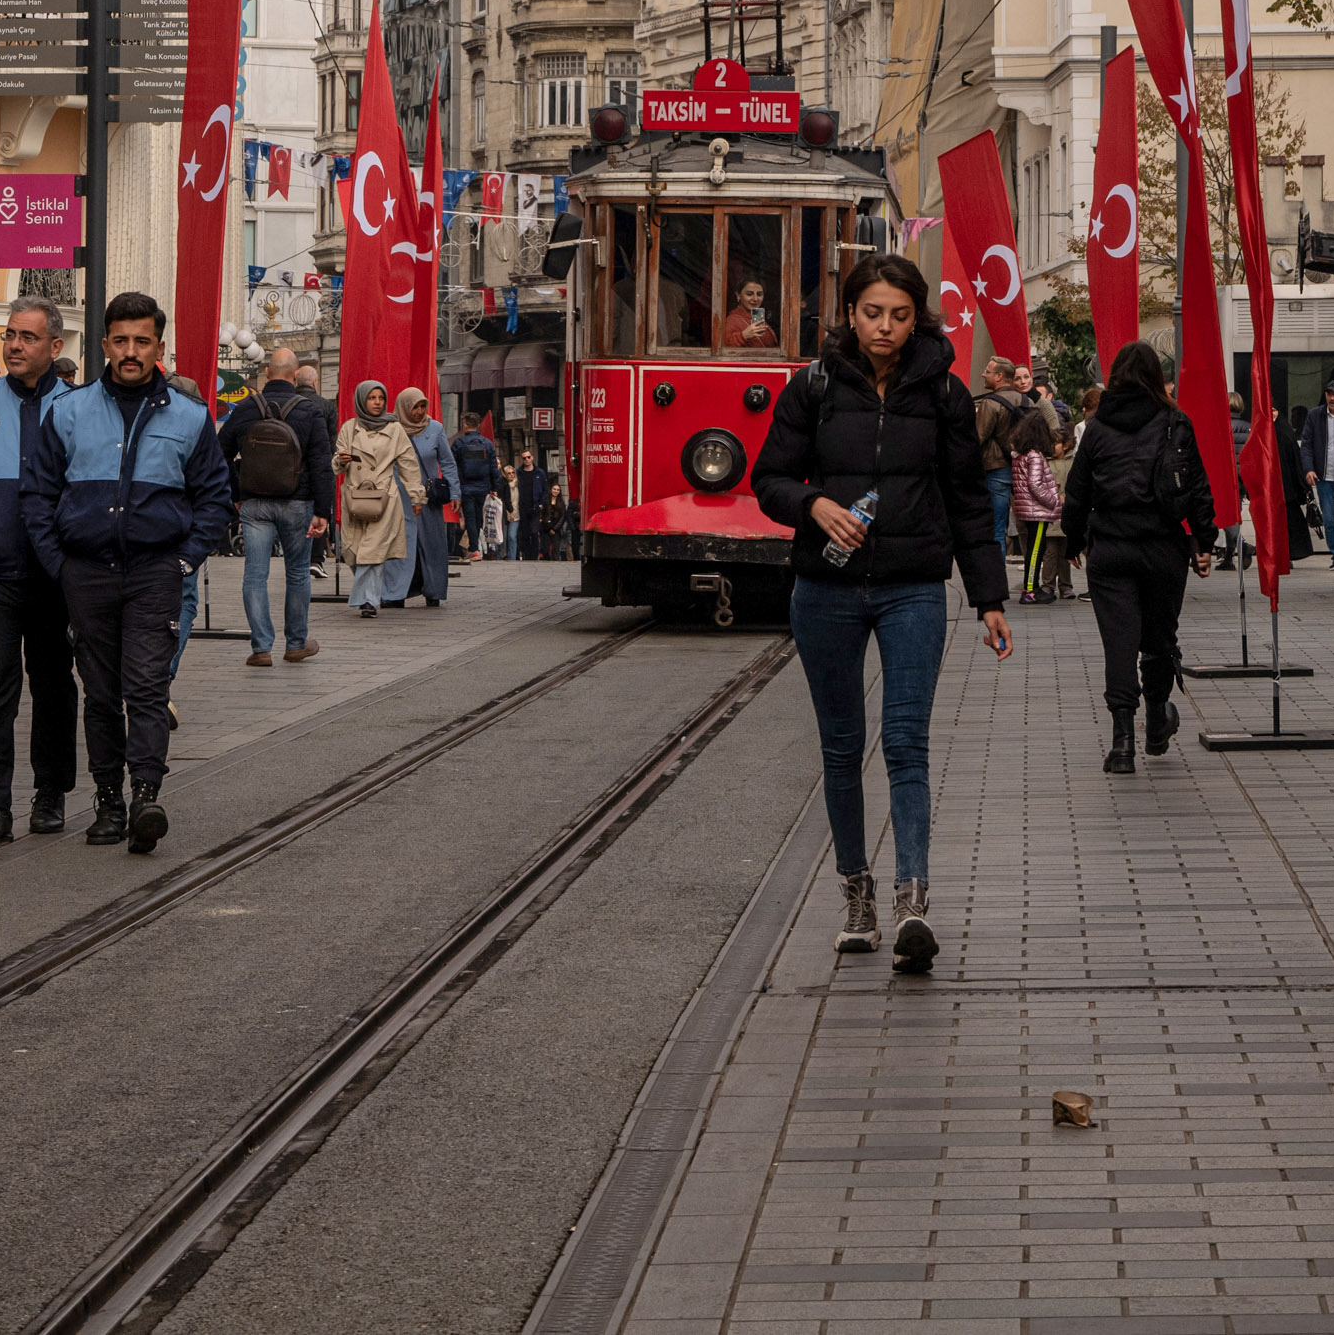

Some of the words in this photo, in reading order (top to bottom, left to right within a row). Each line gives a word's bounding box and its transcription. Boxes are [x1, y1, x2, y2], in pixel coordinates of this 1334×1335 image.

[18, 26, 36, 34] Çarşı
[18, 53, 38, 62] Pasajı
[715, 62, 727, 88] 2
[133, 80, 173, 89] Galatasaray
[648, 96, 707, 122] TAKSİM
[739, 97, 791, 123] TÜNEL
[26, 195, 69, 211] İstiklal
[25, 212, 63, 225] Senin
[27, 245, 63, 254] istiklal.ist
[591, 388, 606, 408] 223
[592, 425, 602, 433] ALO
[603, 425, 614, 433] 153
